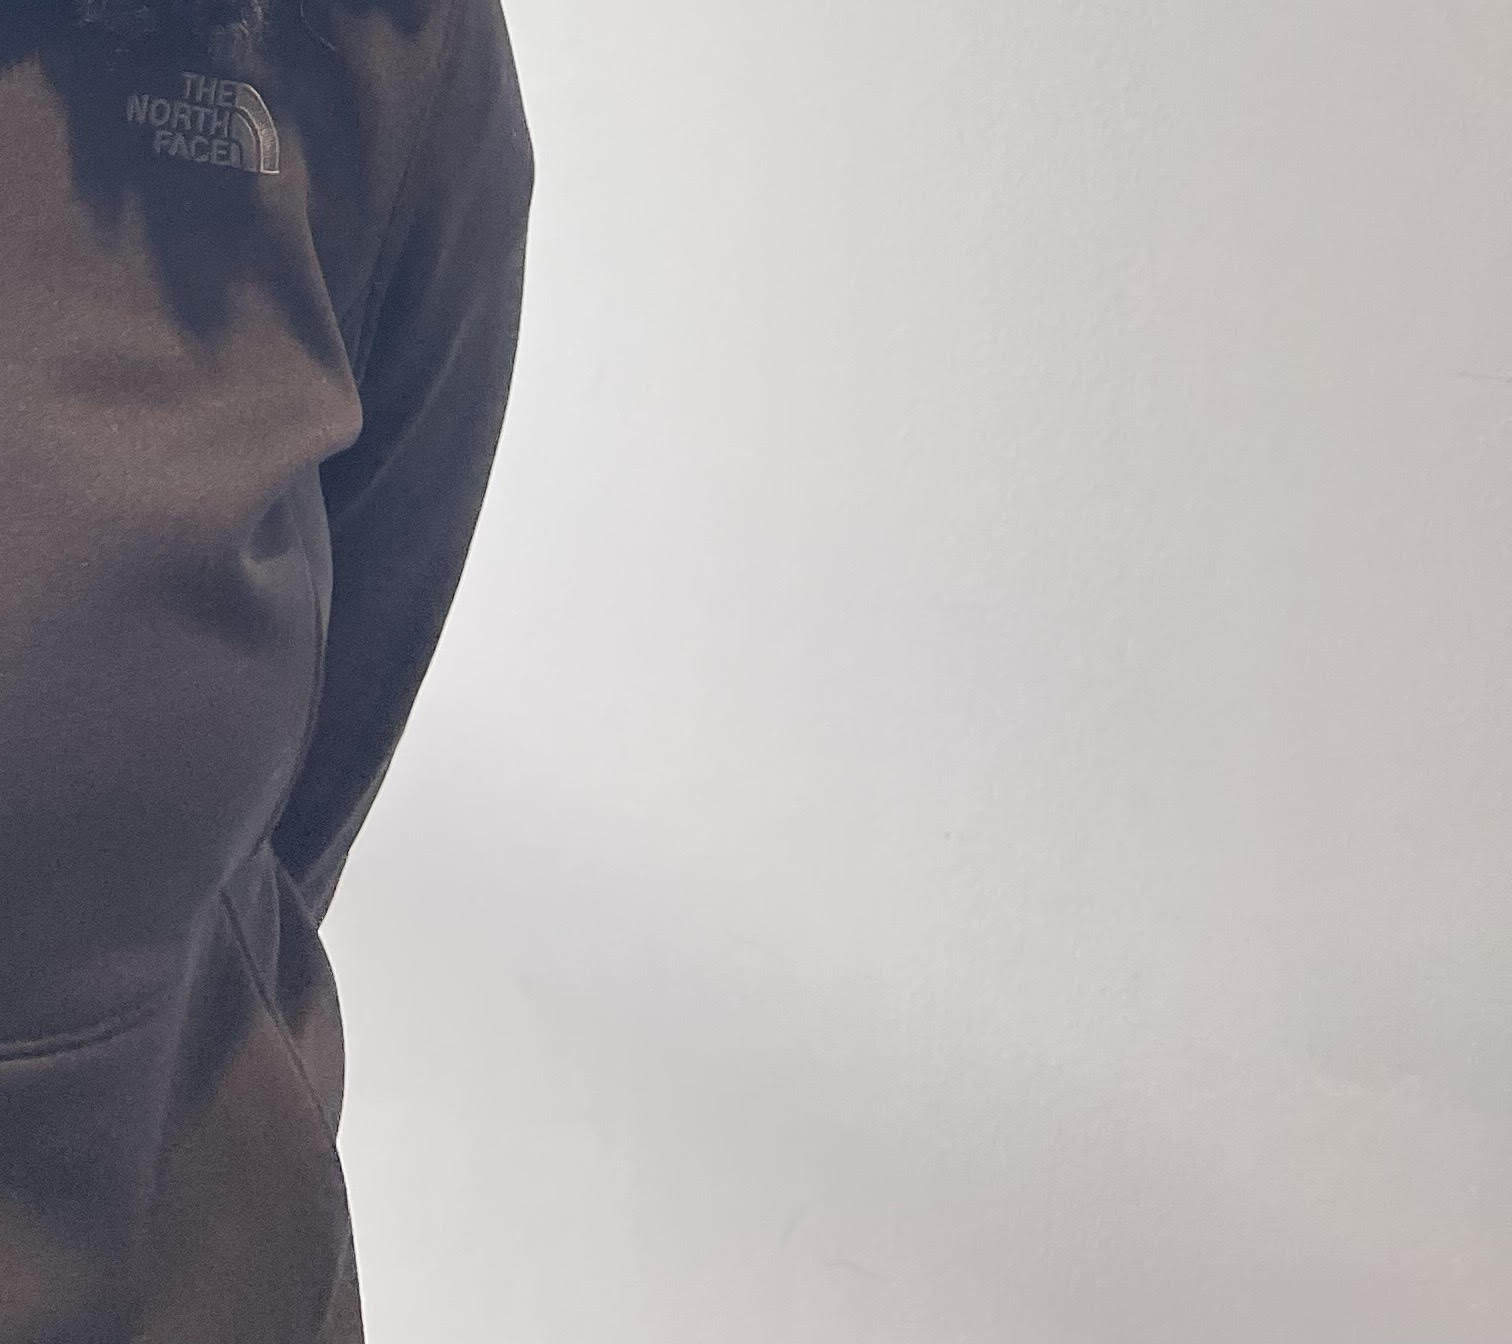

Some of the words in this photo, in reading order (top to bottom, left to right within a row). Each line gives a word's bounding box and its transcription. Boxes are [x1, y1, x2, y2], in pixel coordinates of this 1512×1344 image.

[182, 71, 236, 106] THE
[126, 94, 229, 138] NORTH
[154, 130, 230, 165] FACE
